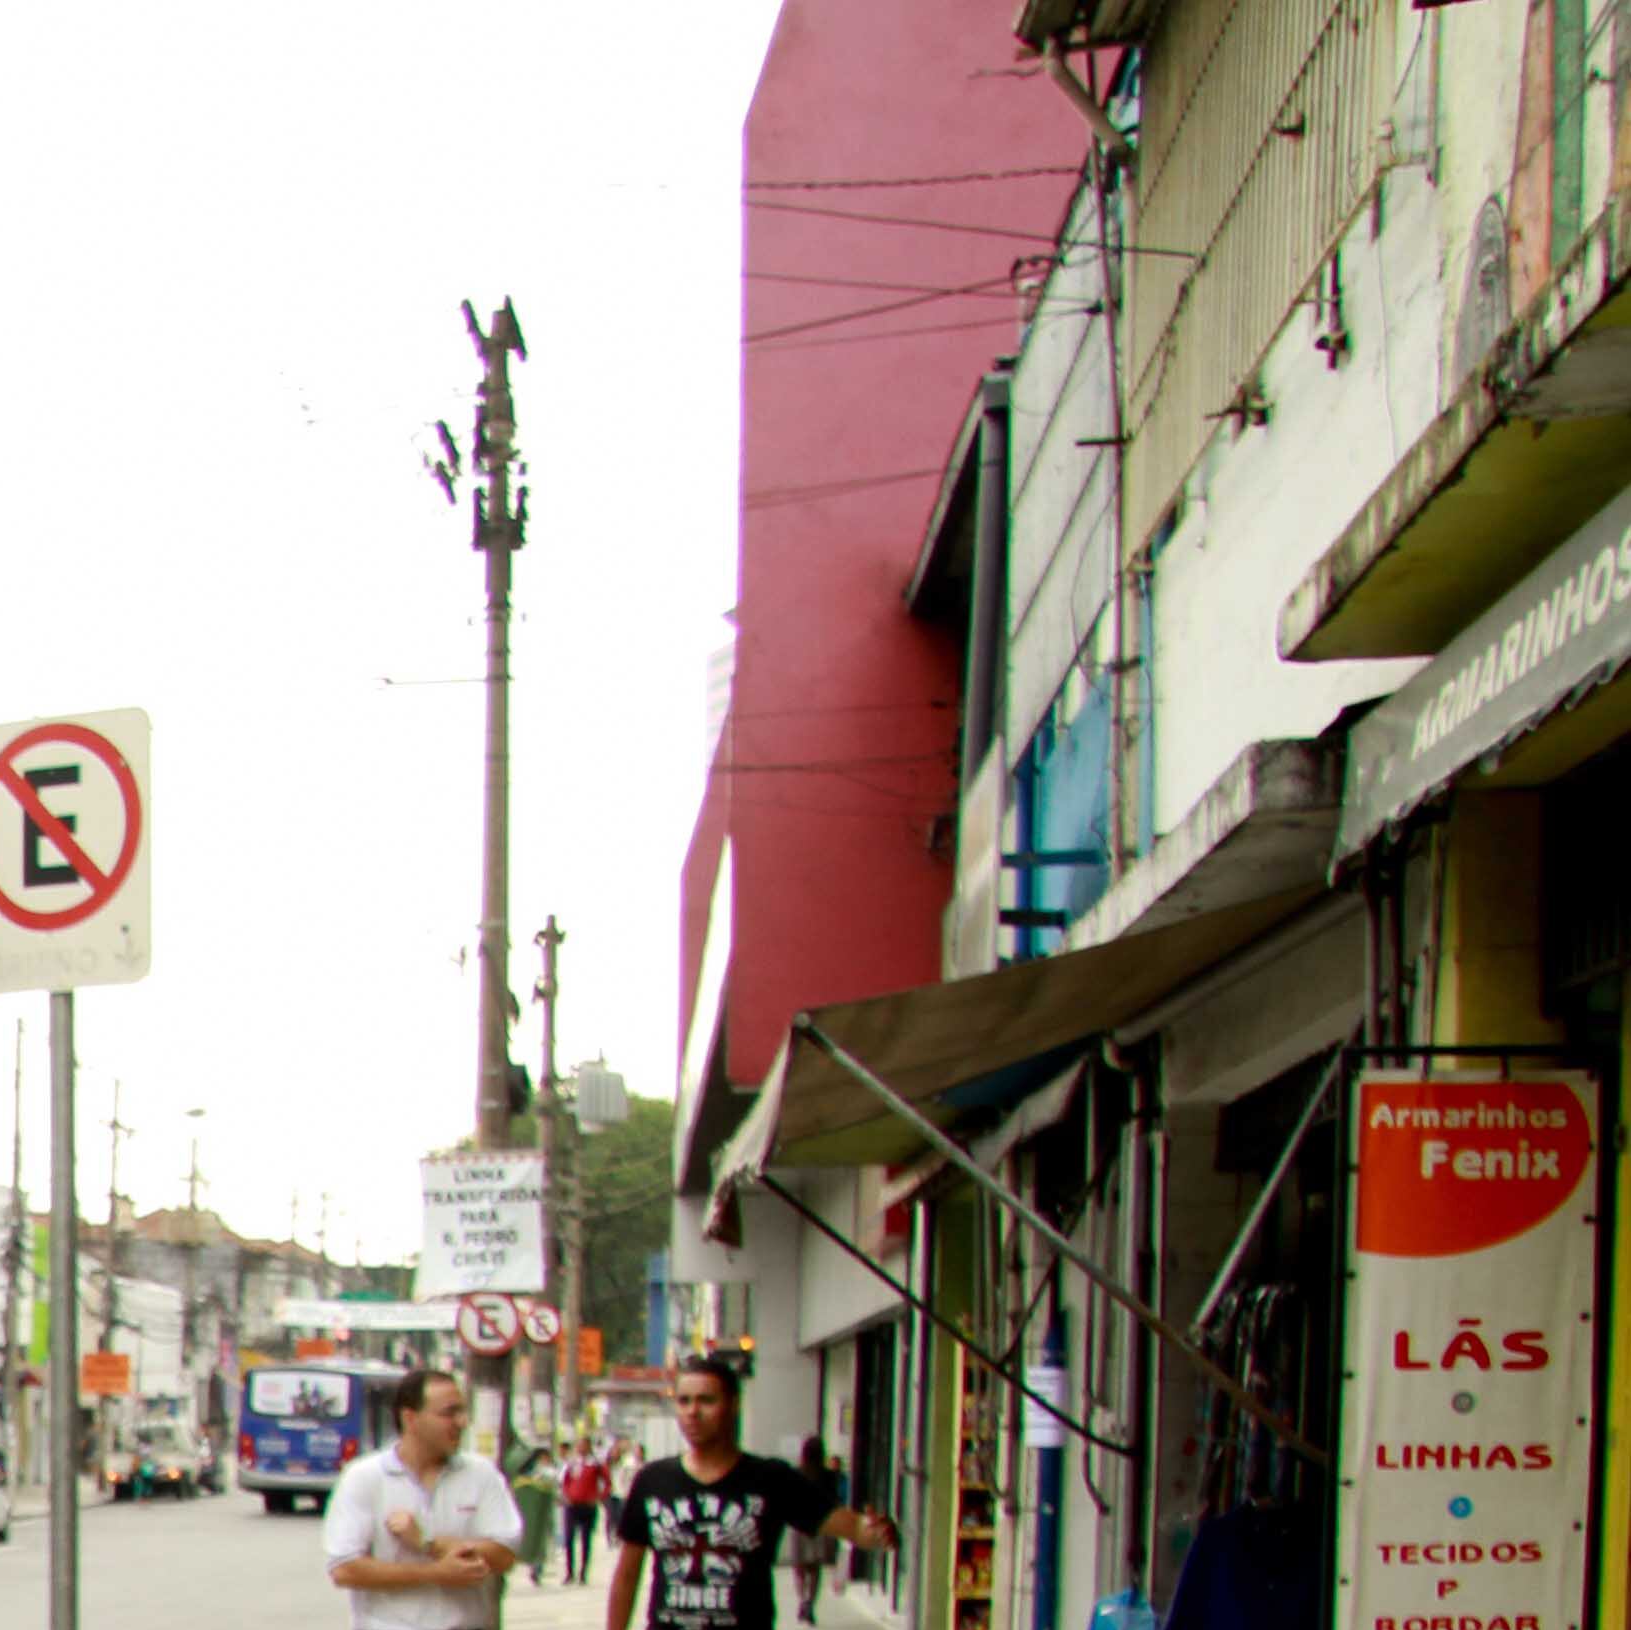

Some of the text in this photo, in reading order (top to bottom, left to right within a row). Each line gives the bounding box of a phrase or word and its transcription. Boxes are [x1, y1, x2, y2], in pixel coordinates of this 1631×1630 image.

[1411, 526, 1631, 760] ARMARINHOS
[23, 765, 81, 888] E
[1370, 1103, 1568, 1129] Armarinhos
[1420, 1139, 1561, 1180] Fenix
[1394, 1318, 1550, 1372] LÃS
[1376, 1444, 1554, 1471] LINHAS
[1377, 1542, 1544, 1565] TECIDOS
[1437, 1578, 1460, 1600] P
